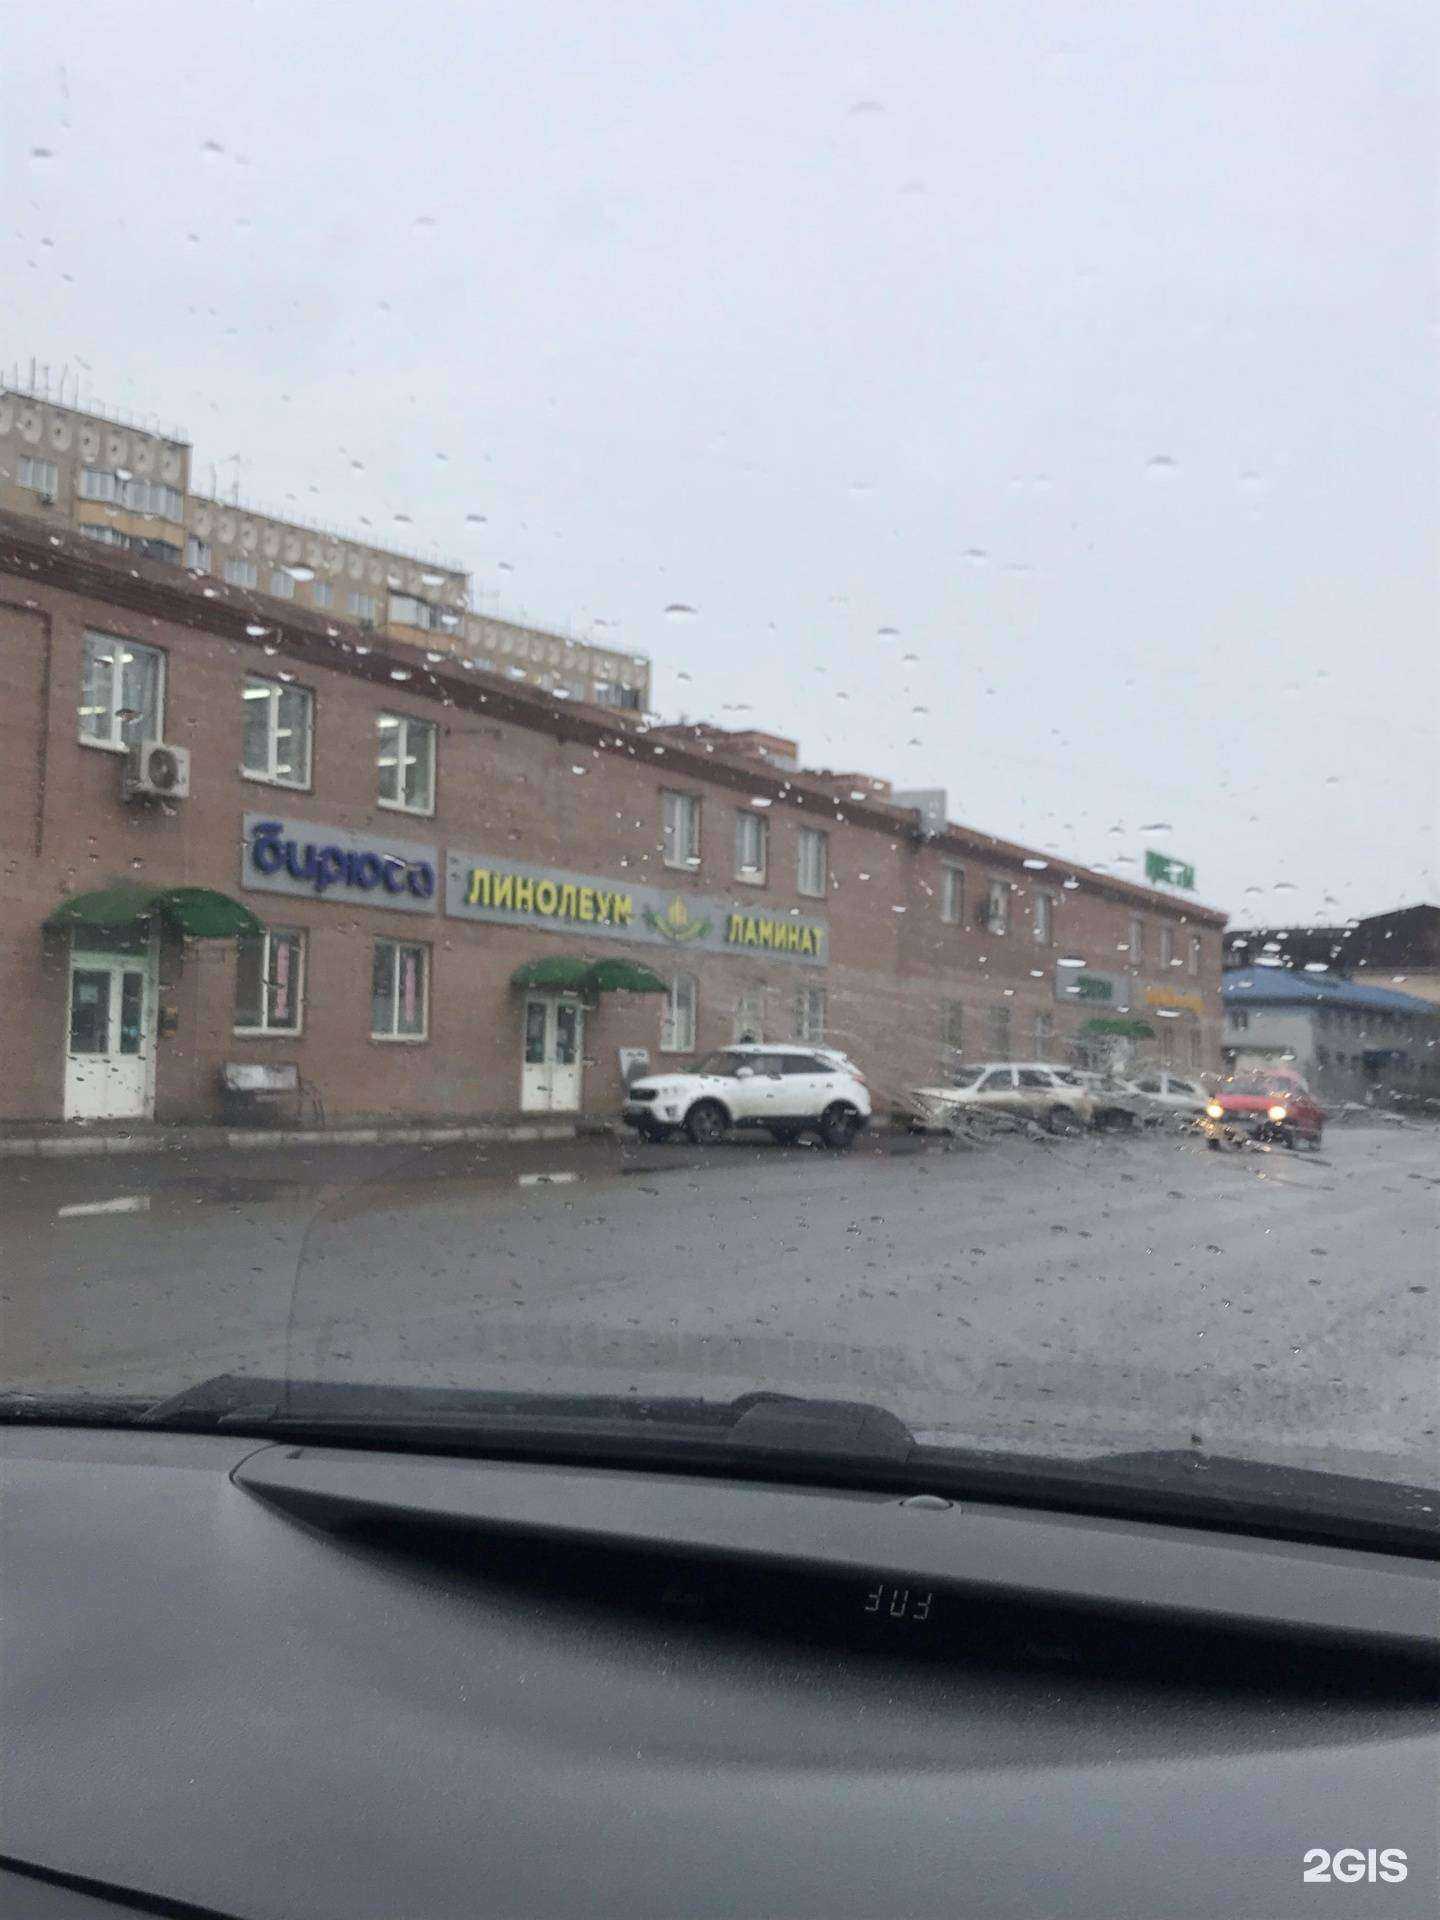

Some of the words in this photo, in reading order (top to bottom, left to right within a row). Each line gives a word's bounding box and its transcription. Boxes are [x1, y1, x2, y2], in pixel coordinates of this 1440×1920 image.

[252, 822, 434, 899] бирюса
[470, 868, 635, 926] ЛИНОЛЕУМ
[728, 913, 824, 956] ЛАМИНАТ
